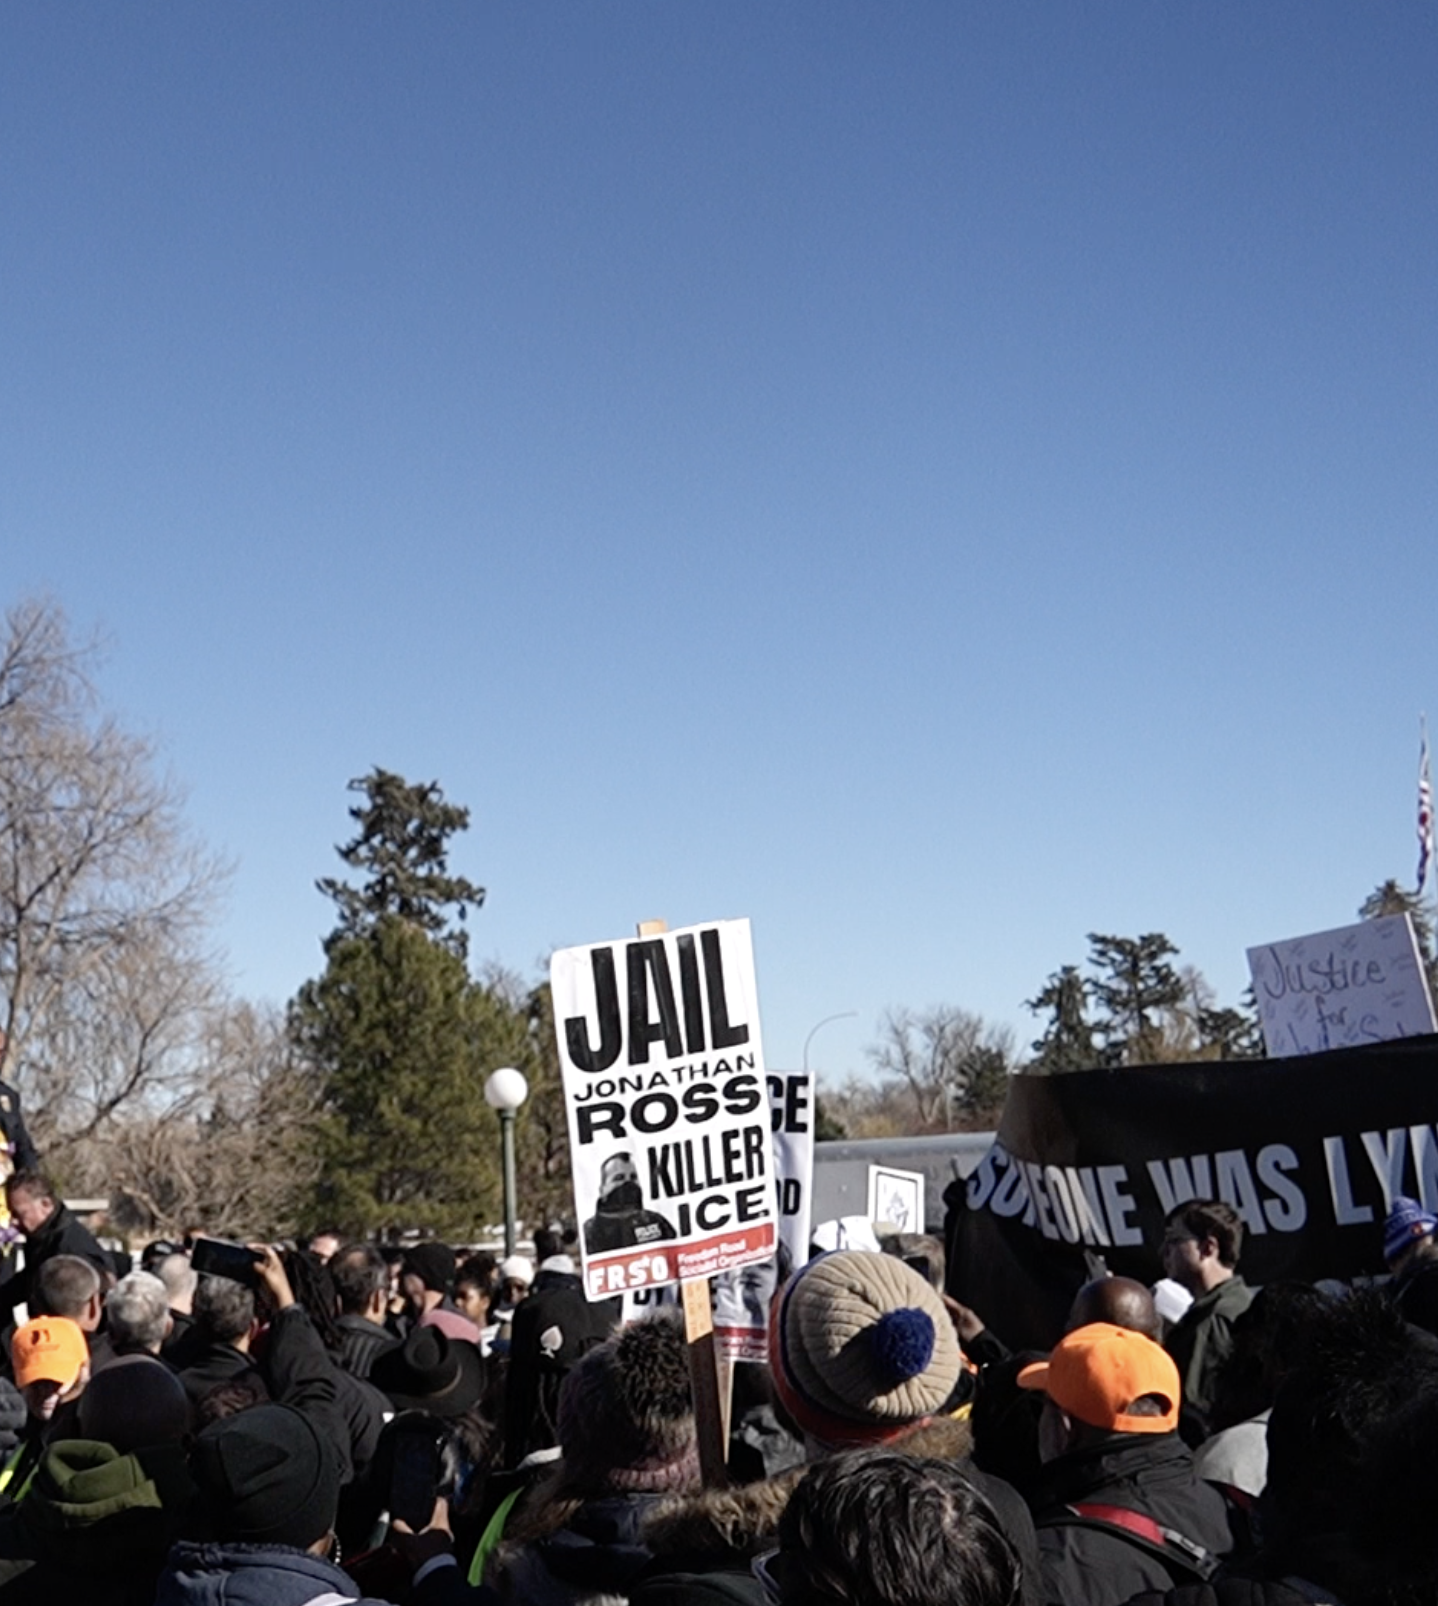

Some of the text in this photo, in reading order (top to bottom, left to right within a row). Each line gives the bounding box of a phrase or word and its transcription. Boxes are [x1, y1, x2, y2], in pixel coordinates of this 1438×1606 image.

[564, 928, 750, 1073] JAIL
[1263, 946, 1386, 999] Justice
[1315, 994, 1348, 1027] for
[573, 1052, 756, 1102] JONATHAN
[575, 1074, 761, 1145] ROSS
[647, 1124, 766, 1200] KILLER
[1145, 1143, 1307, 1235] WAS
[677, 1185, 770, 1238] ICE
